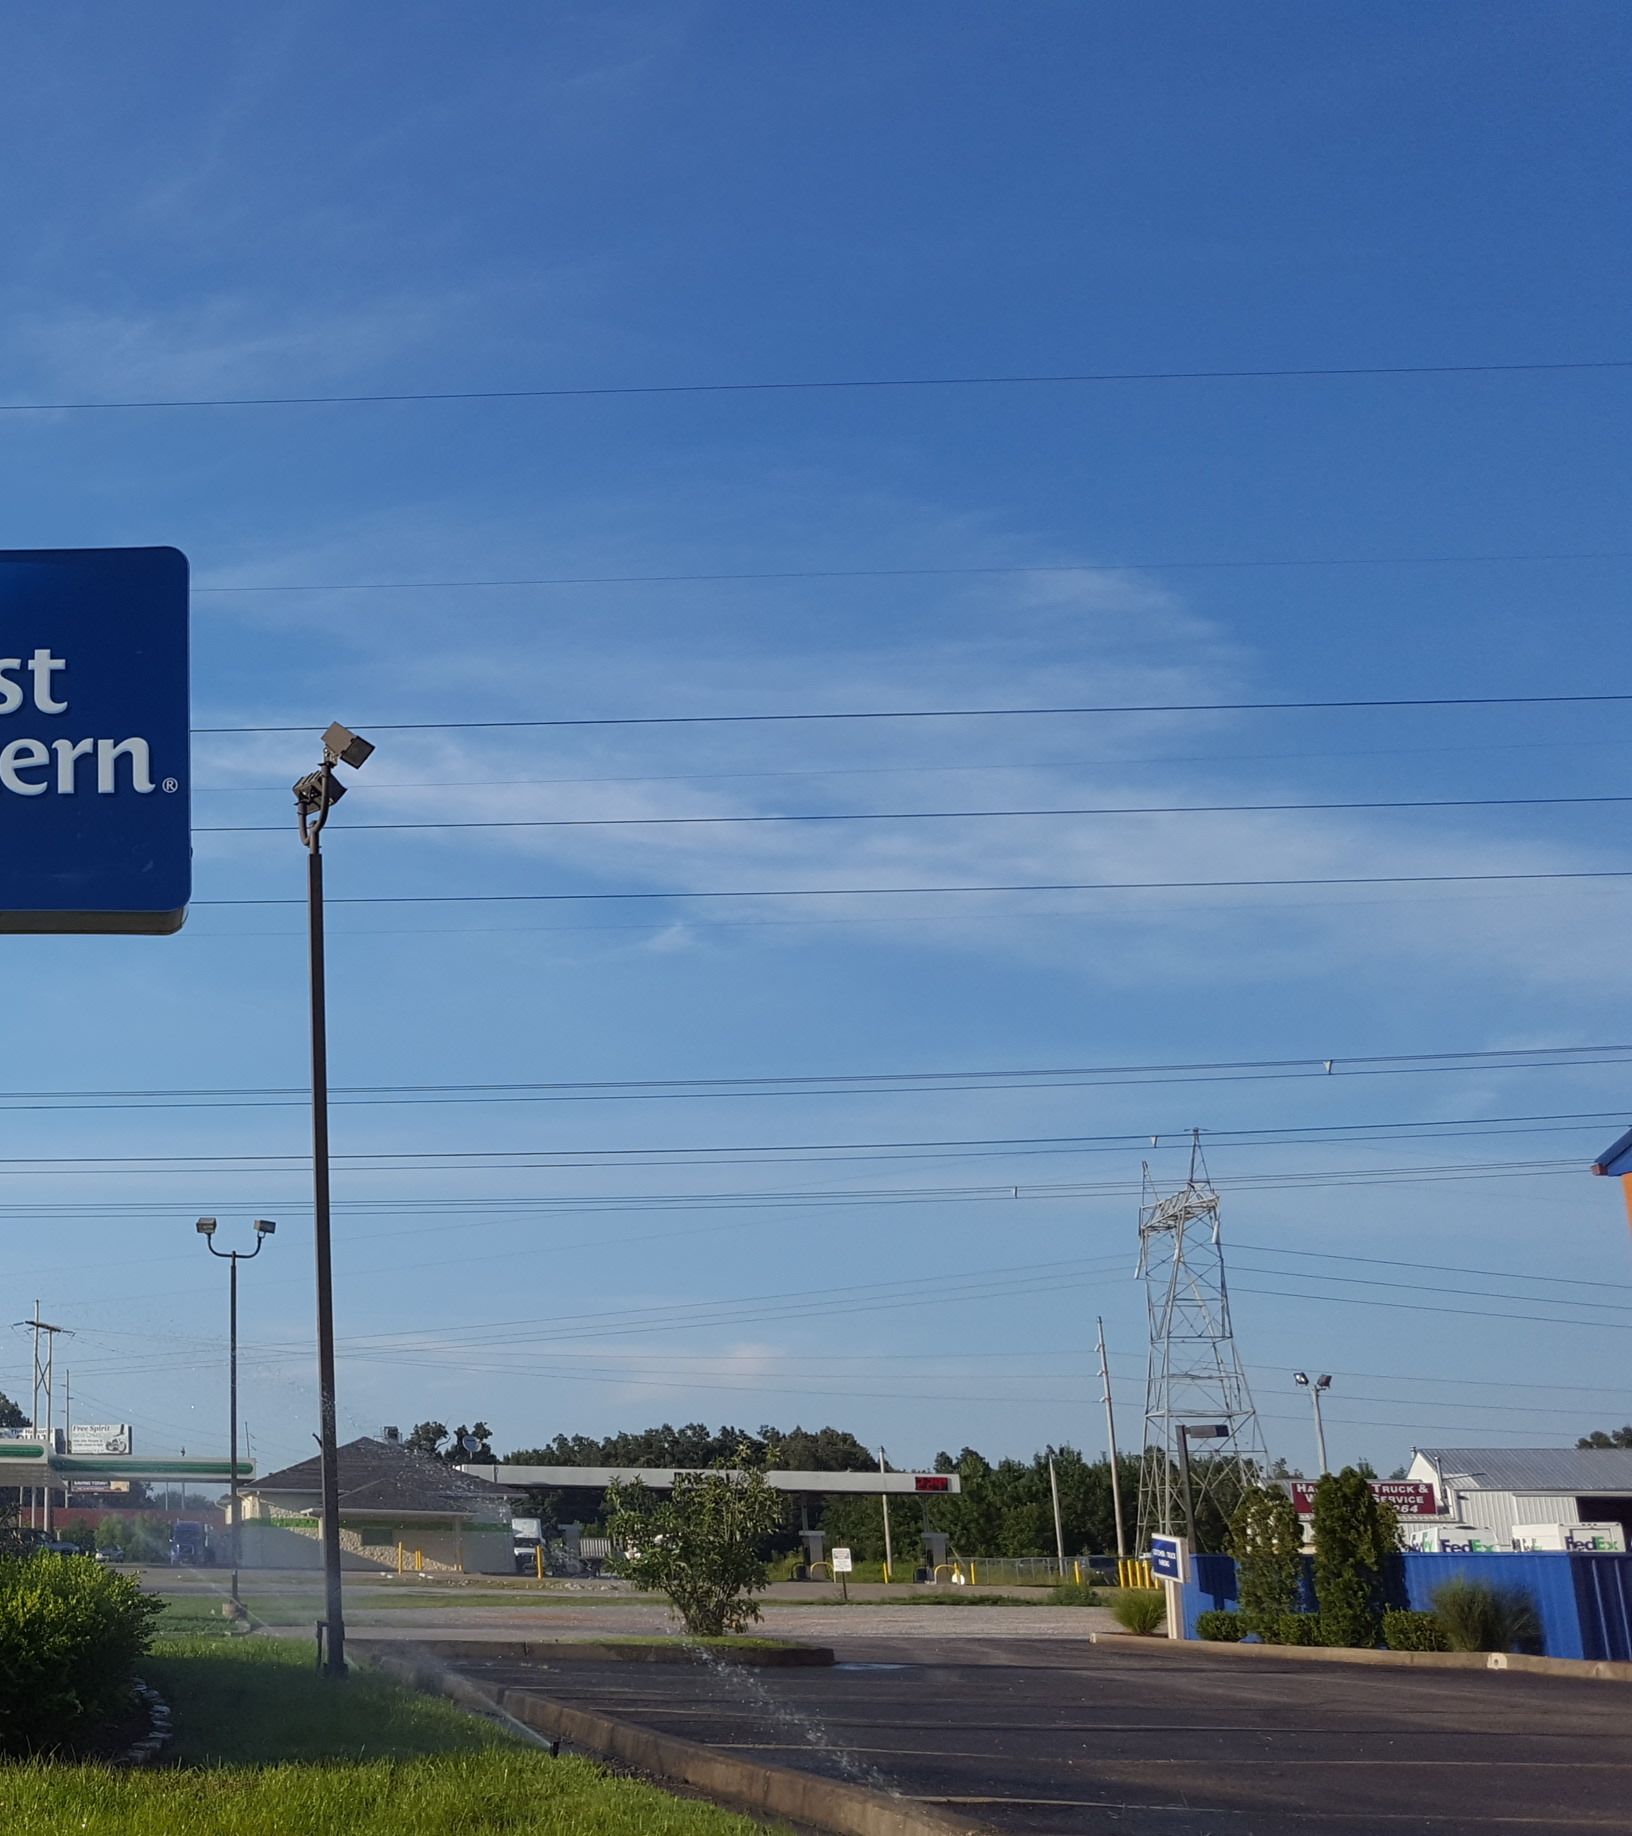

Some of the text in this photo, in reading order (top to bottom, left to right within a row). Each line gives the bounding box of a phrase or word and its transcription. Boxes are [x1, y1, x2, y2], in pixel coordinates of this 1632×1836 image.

[72, 1424, 111, 1433] Free Spirit
[1372, 1483, 1429, 1494] TRUCK &
[1440, 1539, 1495, 1552] FedEx
[1565, 1536, 1619, 1551] FedEx
